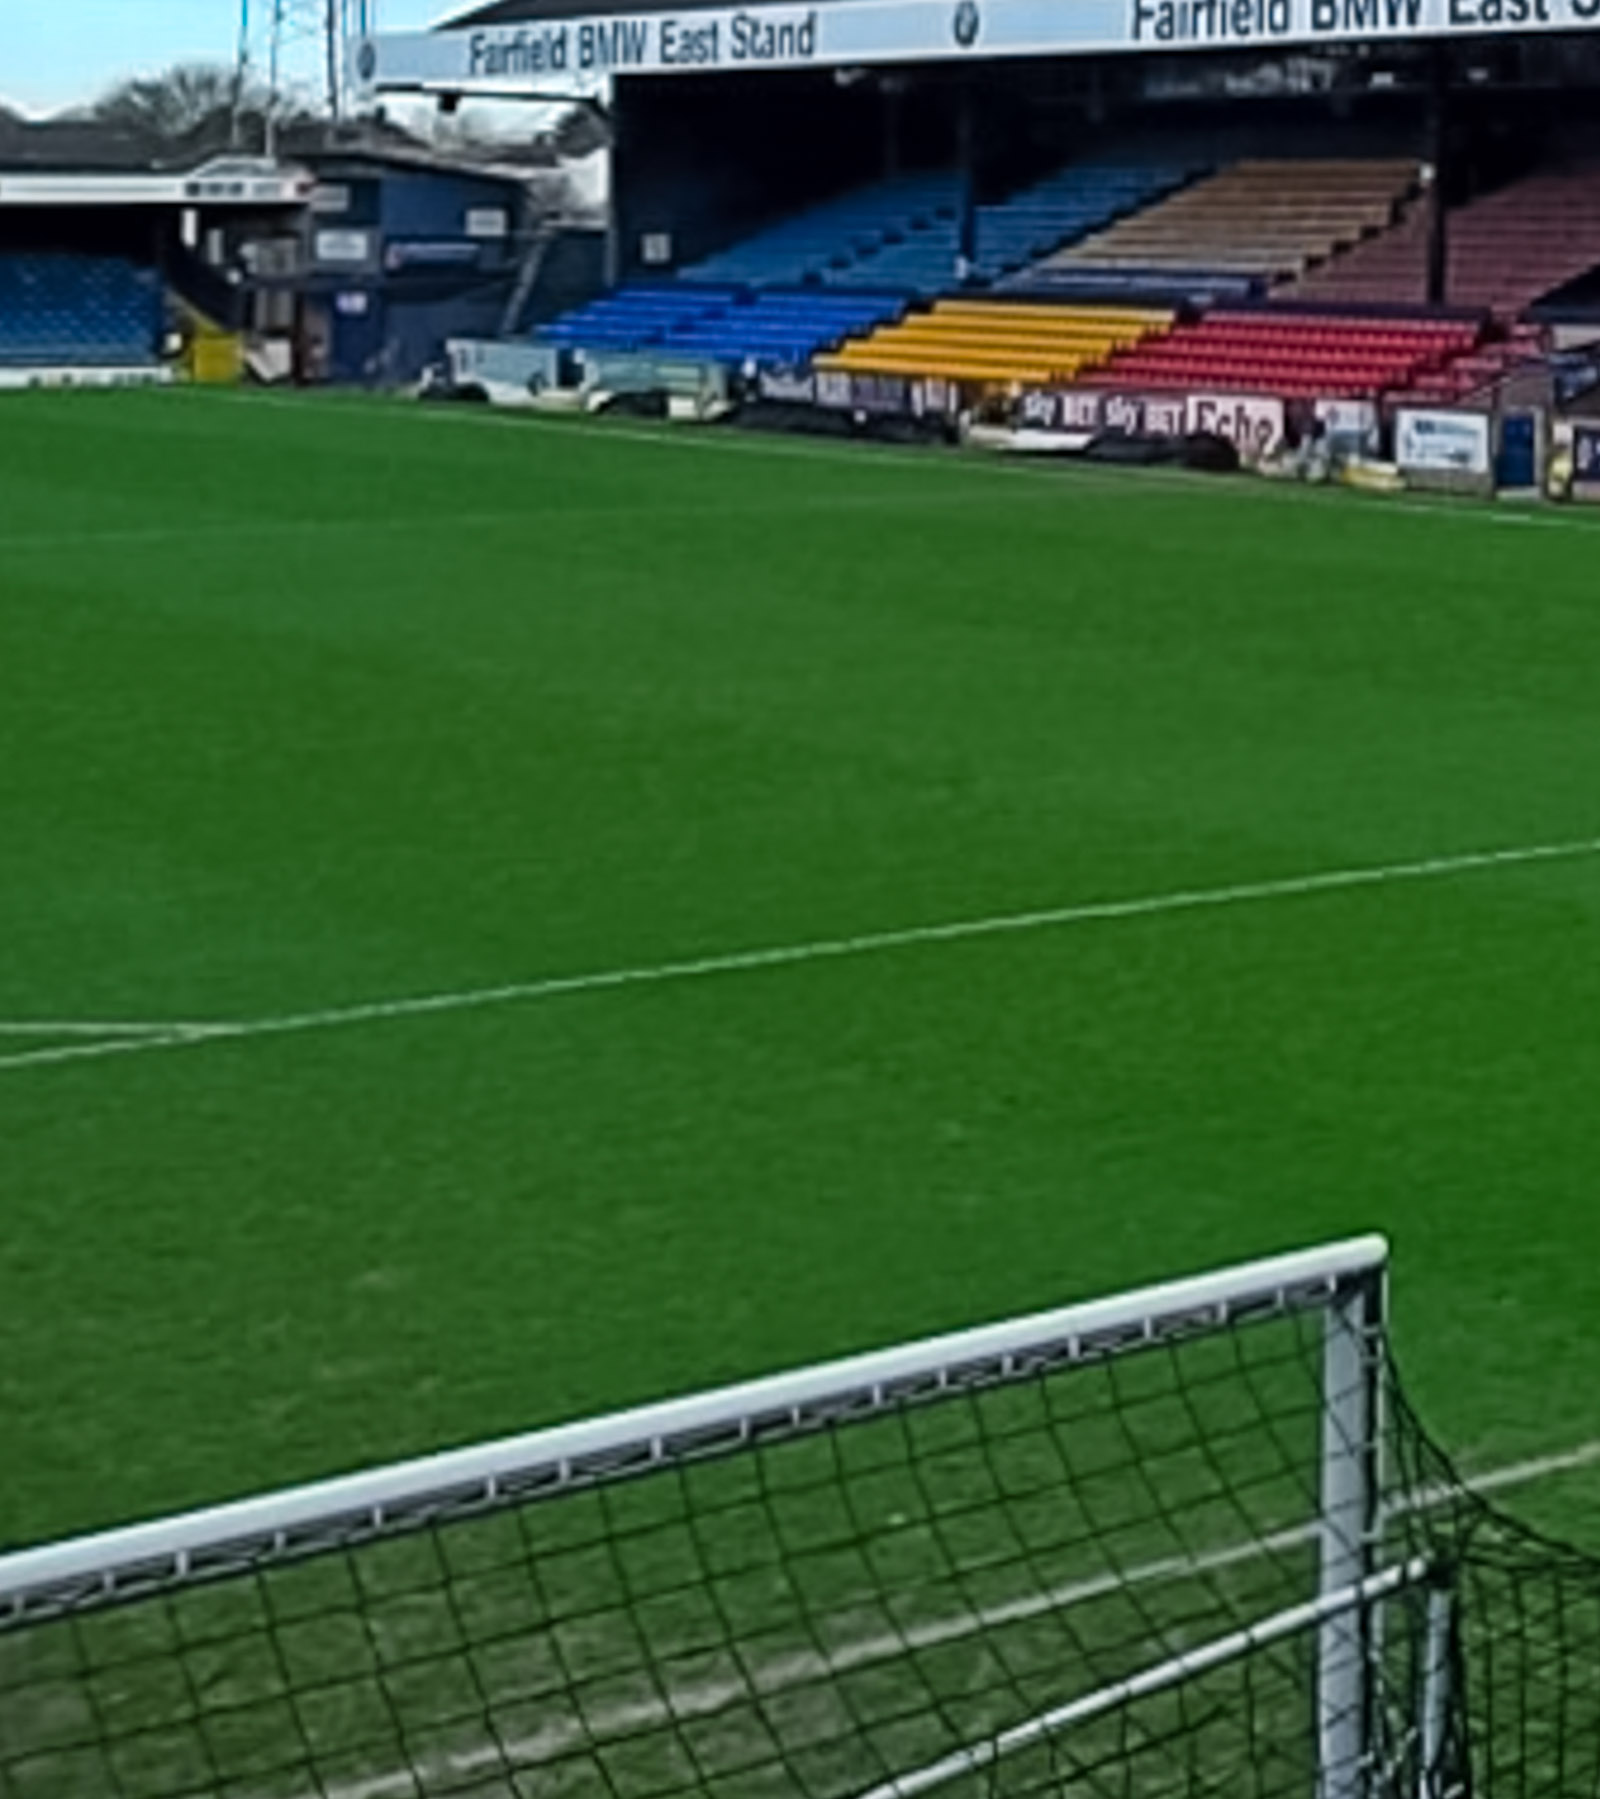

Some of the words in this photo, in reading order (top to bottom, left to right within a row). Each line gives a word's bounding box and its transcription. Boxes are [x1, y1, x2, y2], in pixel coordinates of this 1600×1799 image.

[469, 25, 567, 75] Fairfield
[578, 20, 648, 68] BMW
[659, 19, 720, 65] East
[731, 11, 818, 60] Stand
